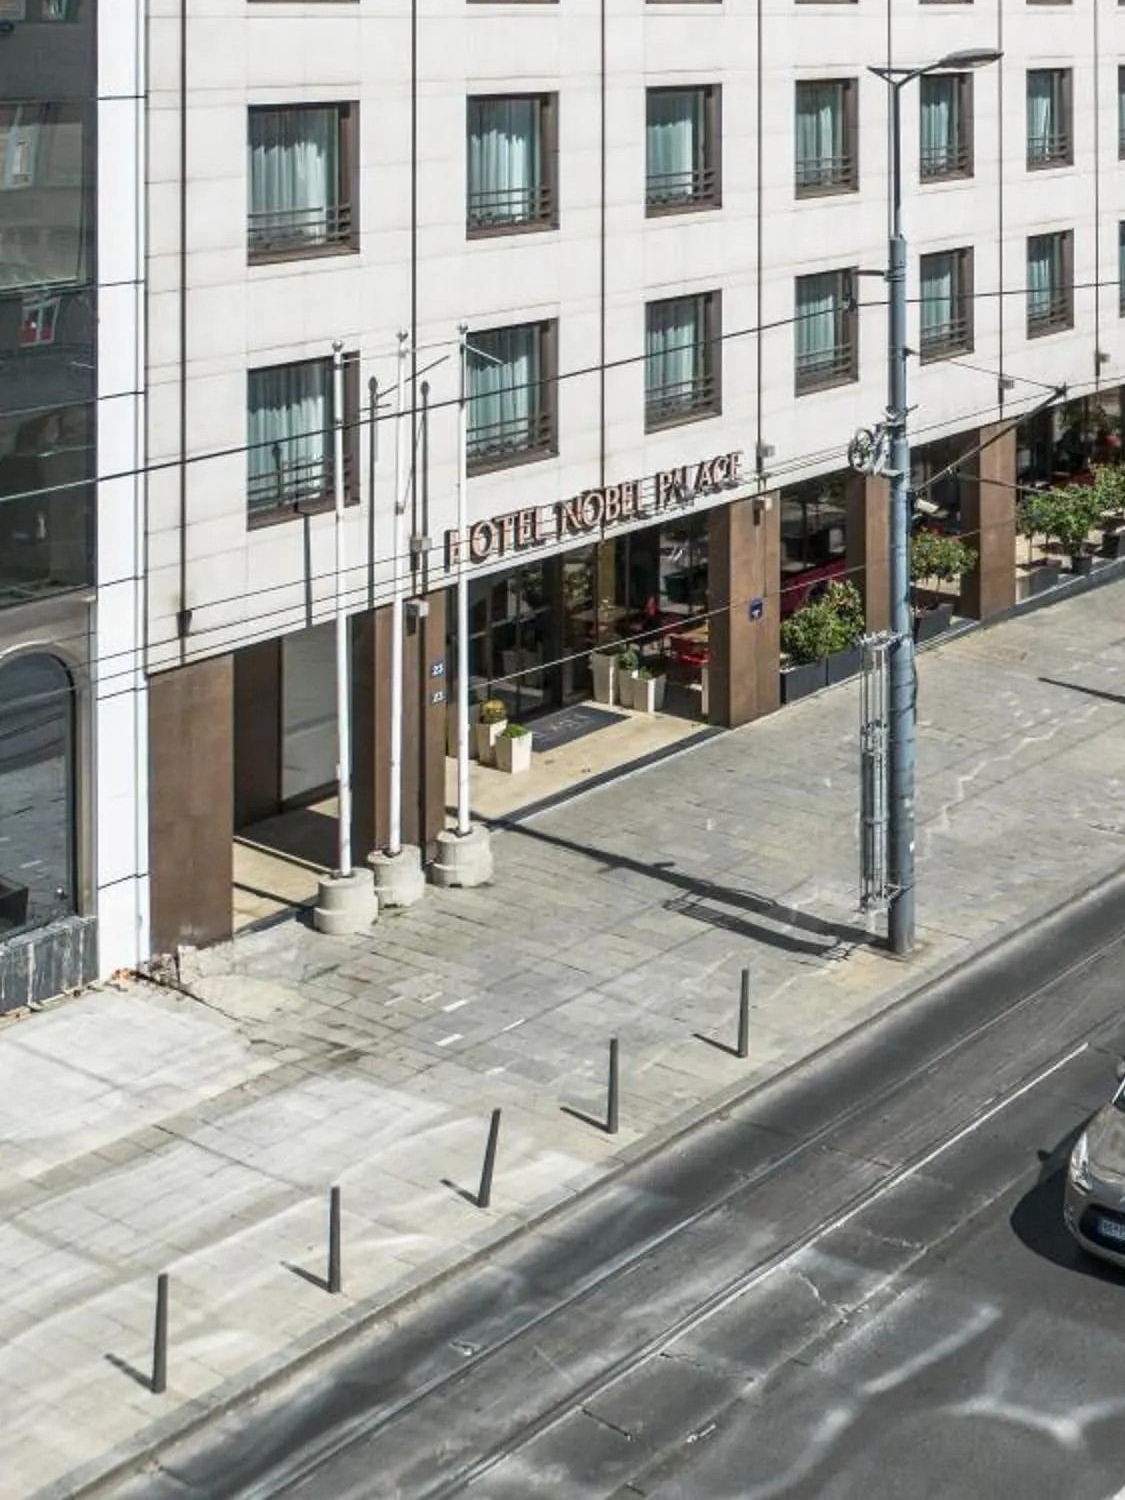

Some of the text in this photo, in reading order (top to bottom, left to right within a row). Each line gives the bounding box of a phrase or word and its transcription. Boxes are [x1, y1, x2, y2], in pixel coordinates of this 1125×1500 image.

[445, 451, 745, 571] HOTEL NOBEL PALACE
